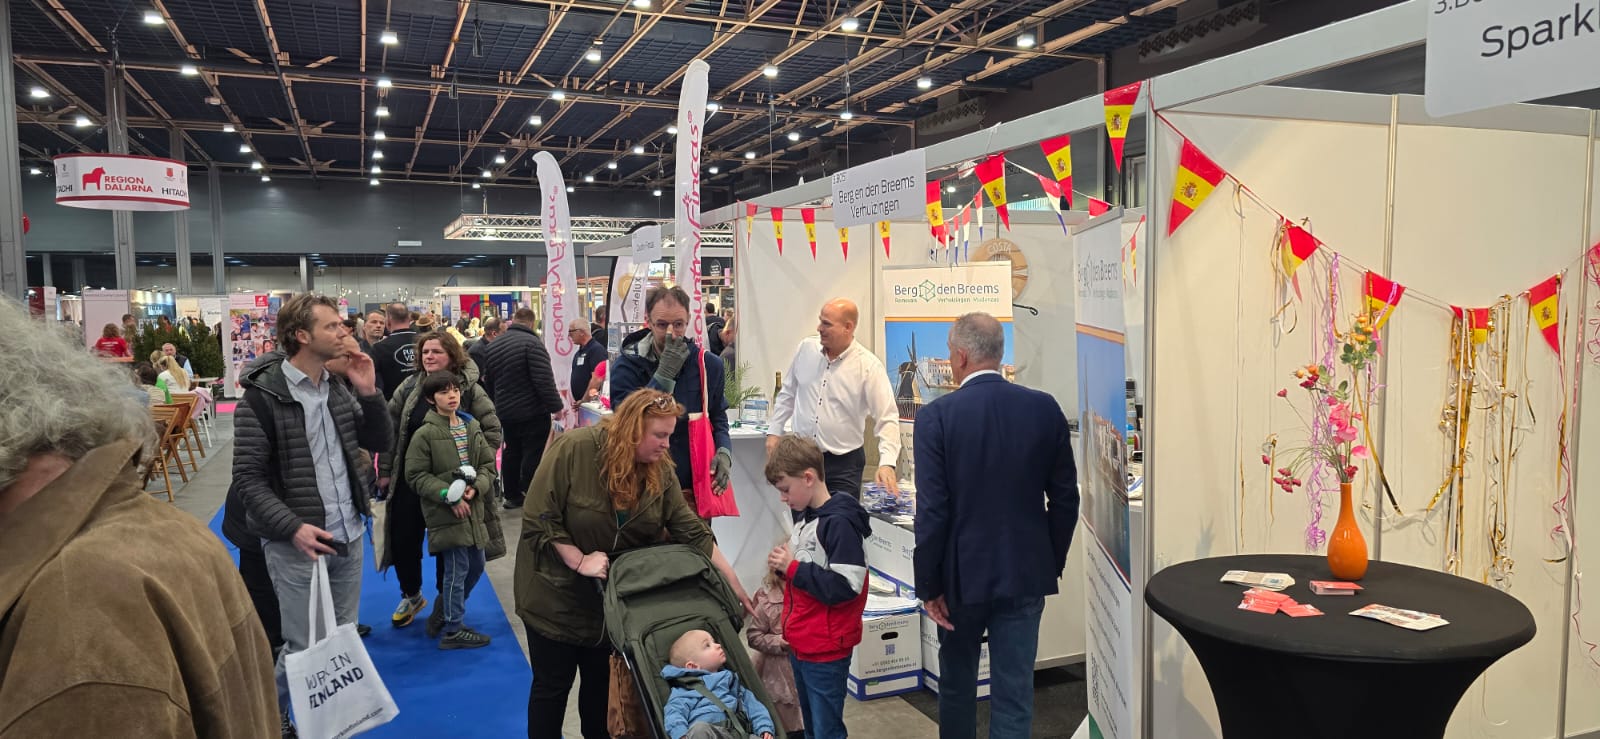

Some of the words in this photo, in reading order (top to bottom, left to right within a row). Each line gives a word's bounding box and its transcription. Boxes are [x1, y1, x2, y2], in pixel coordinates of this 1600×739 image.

[1481, 2, 1600, 58] Spark
[104, 176, 144, 184] REGION
[104, 184, 153, 193] DALARNA
[838, 190, 854, 204] Berg
[854, 188, 864, 200] en
[865, 182, 880, 198] den
[881, 175, 915, 194] Breems
[894, 284, 918, 297] Berg
[936, 283, 956, 295] den
[957, 283, 999, 295] Breems
[330, 652, 352, 672] IN
